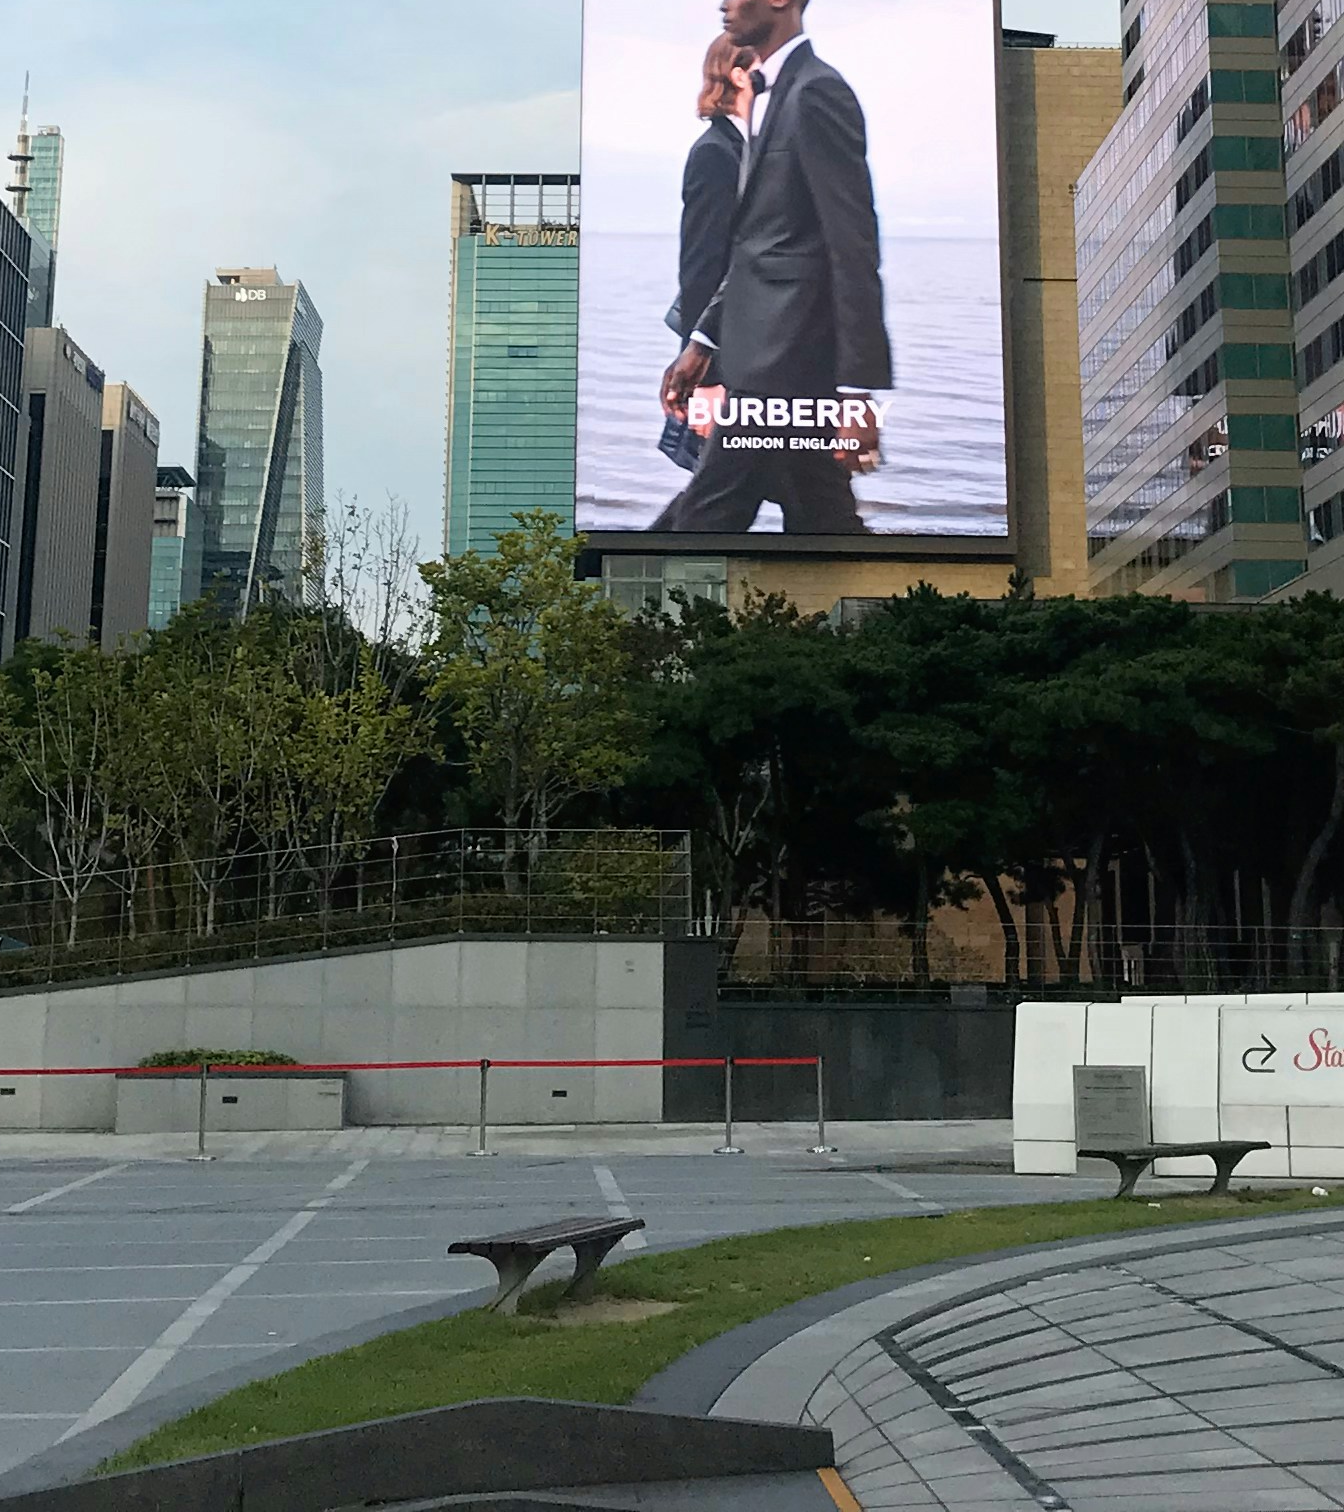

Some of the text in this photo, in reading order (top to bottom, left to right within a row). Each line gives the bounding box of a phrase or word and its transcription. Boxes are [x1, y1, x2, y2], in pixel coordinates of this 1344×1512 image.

[485, 224, 578, 247] K-TOWER
[248, 289, 267, 301] DB
[687, 395, 895, 429] BURBERRY
[722, 435, 861, 451] LONDON ENGLAND
